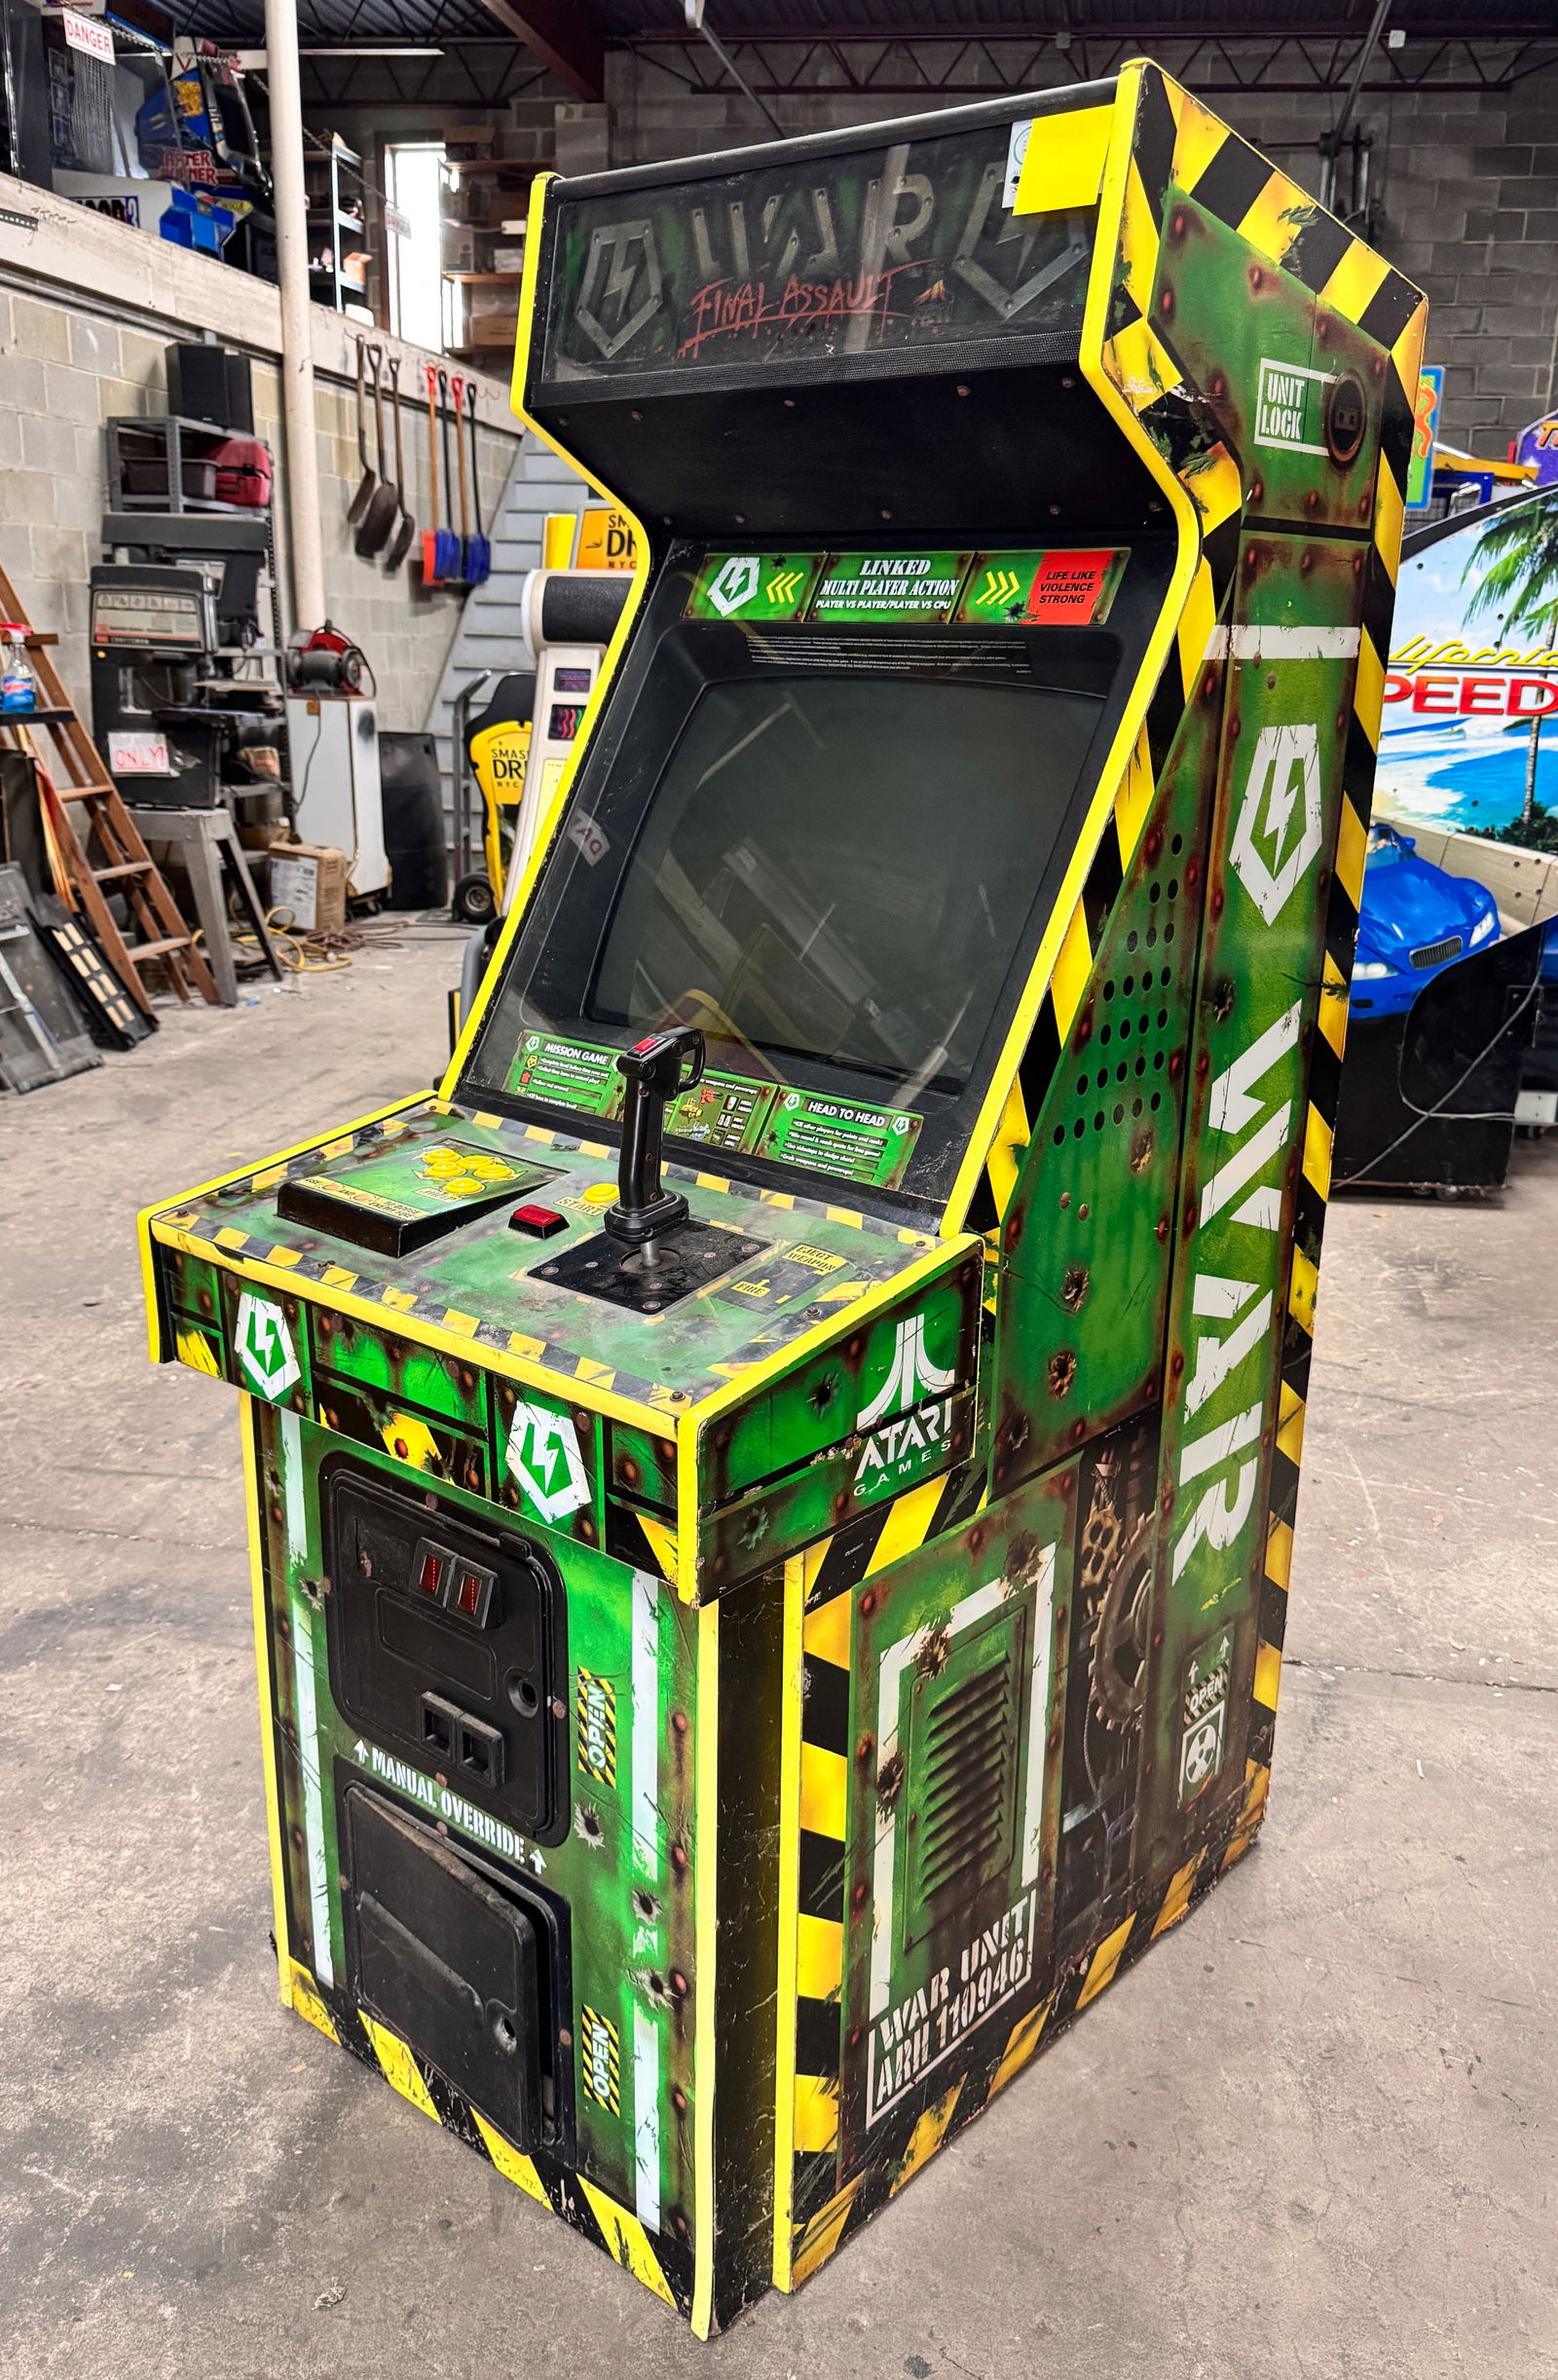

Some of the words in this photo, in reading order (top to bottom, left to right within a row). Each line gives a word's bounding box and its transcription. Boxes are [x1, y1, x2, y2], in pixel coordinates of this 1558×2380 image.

[67, 19, 112, 54] DANGER
[689, 278, 781, 358] FINAL
[779, 257, 937, 344] ASSAULT
[1268, 373, 1305, 407] UNIT
[1261, 404, 1302, 439] LOCK
[859, 559, 932, 576] LINKED
[1046, 571, 1069, 580] LIFE
[1069, 571, 1096, 580] LIKE
[820, 579, 861, 596] MULTI
[859, 579, 908, 596] PLAYER
[909, 578, 960, 596] ACTION
[1039, 594, 1086, 604] STRONG
[1040, 582, 1094, 592] VIOLENCE
[815, 600, 845, 609] PLAYER
[845, 600, 857, 609] VS
[857, 600, 919, 610] PLAYER/PLAYER
[920, 601, 933, 610] VS
[933, 601, 952, 610] CPU
[492, 759, 527, 780] DR
[544, 1042, 582, 1059] MISSION
[581, 1052, 610, 1065] GAME
[807, 1101, 838, 1117] HEAD
[838, 1108, 855, 1121] TO
[855, 1114, 886, 1128] HEAD
[559, 1198, 604, 1214] START
[788, 1252, 835, 1272] WEAPON
[797, 1246, 835, 1261] EJECT
[736, 1283, 766, 1295] FIRE
[1170, 996, 1303, 1589] WAR
[854, 1396, 953, 1482] ATARI
[853, 1438, 951, 1498] GAMES
[1188, 1671, 1224, 1712] OPEN
[586, 1684, 606, 1769] OPEN
[371, 1745, 437, 1809] MANUAL
[440, 1789, 526, 1865] OVERRIDE
[879, 1966, 950, 2052] WAR
[960, 1895, 1029, 1983] UNIT
[591, 2020, 611, 2099] OPEN
